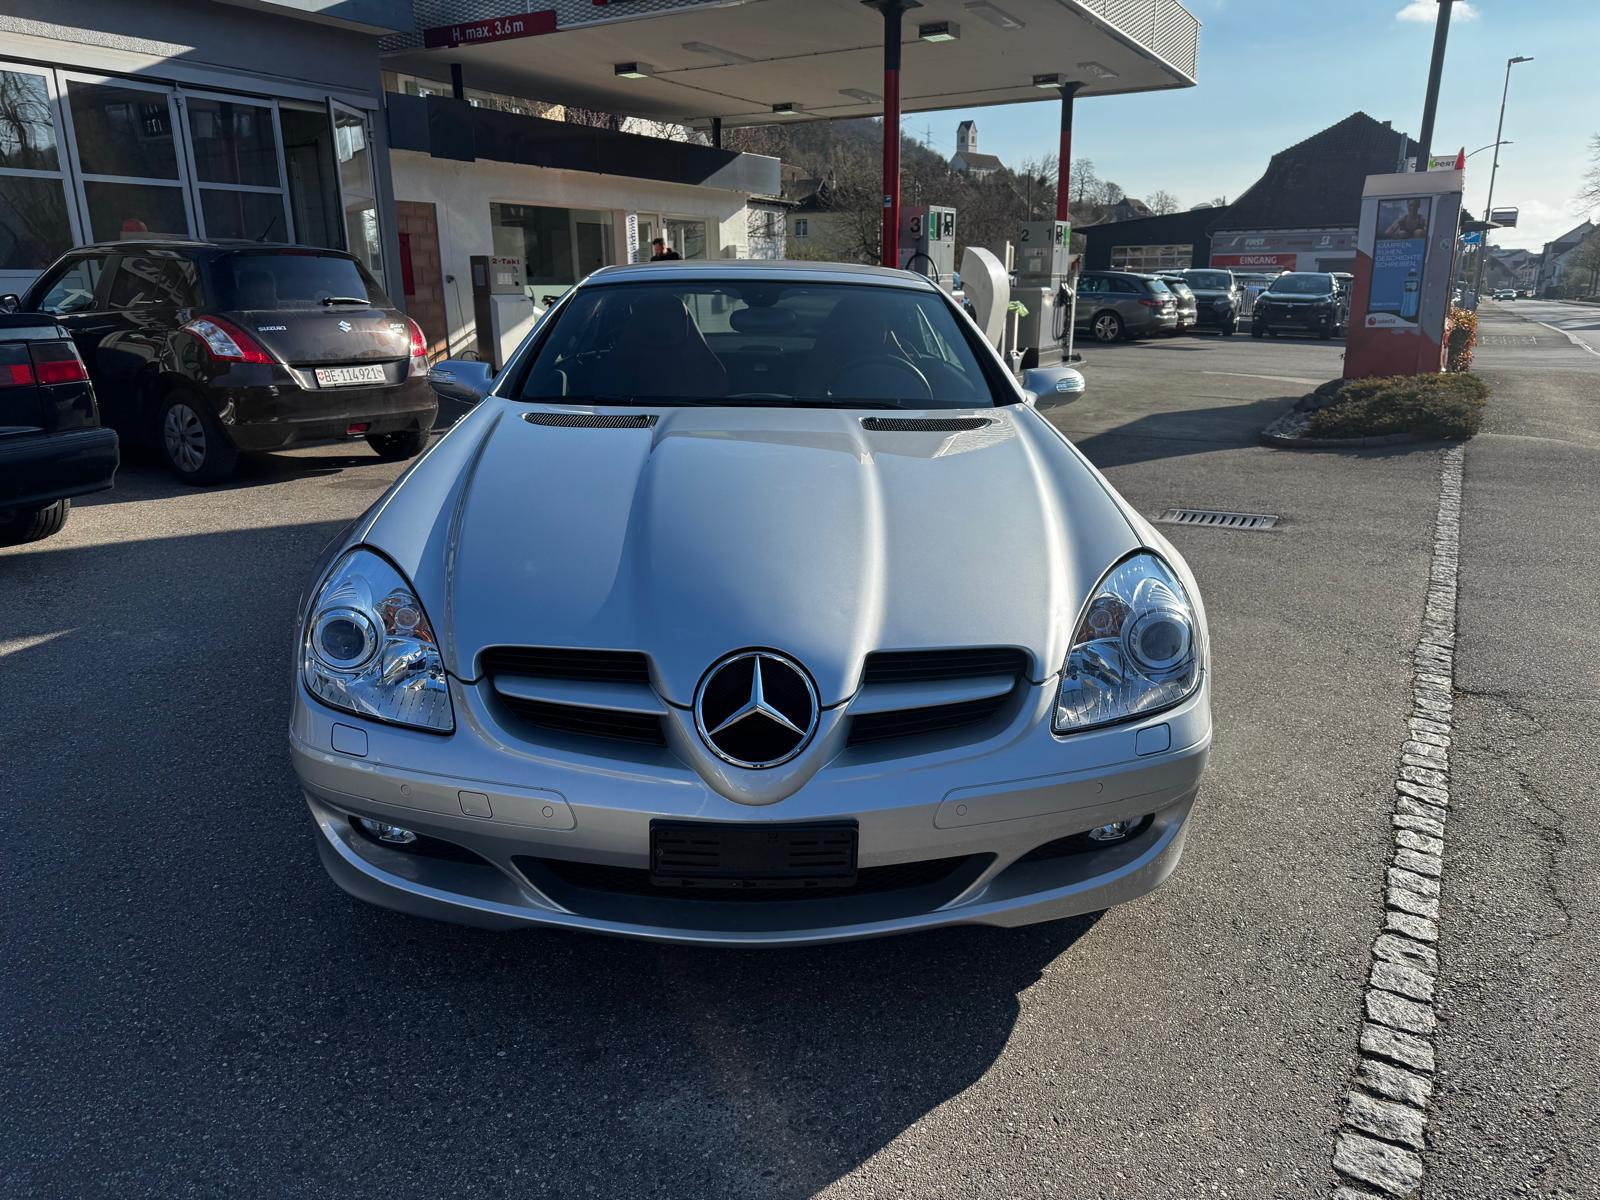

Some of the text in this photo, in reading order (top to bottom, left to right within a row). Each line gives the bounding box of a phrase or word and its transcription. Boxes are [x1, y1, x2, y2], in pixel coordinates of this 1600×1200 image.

[452, 27, 464, 42] H.
[466, 25, 492, 40] max.
[910, 217, 920, 233] 3
[1021, 228, 1052, 242] 2 1
[491, 257, 520, 265] 2-Takt
[1240, 256, 1277, 264] EINGANG
